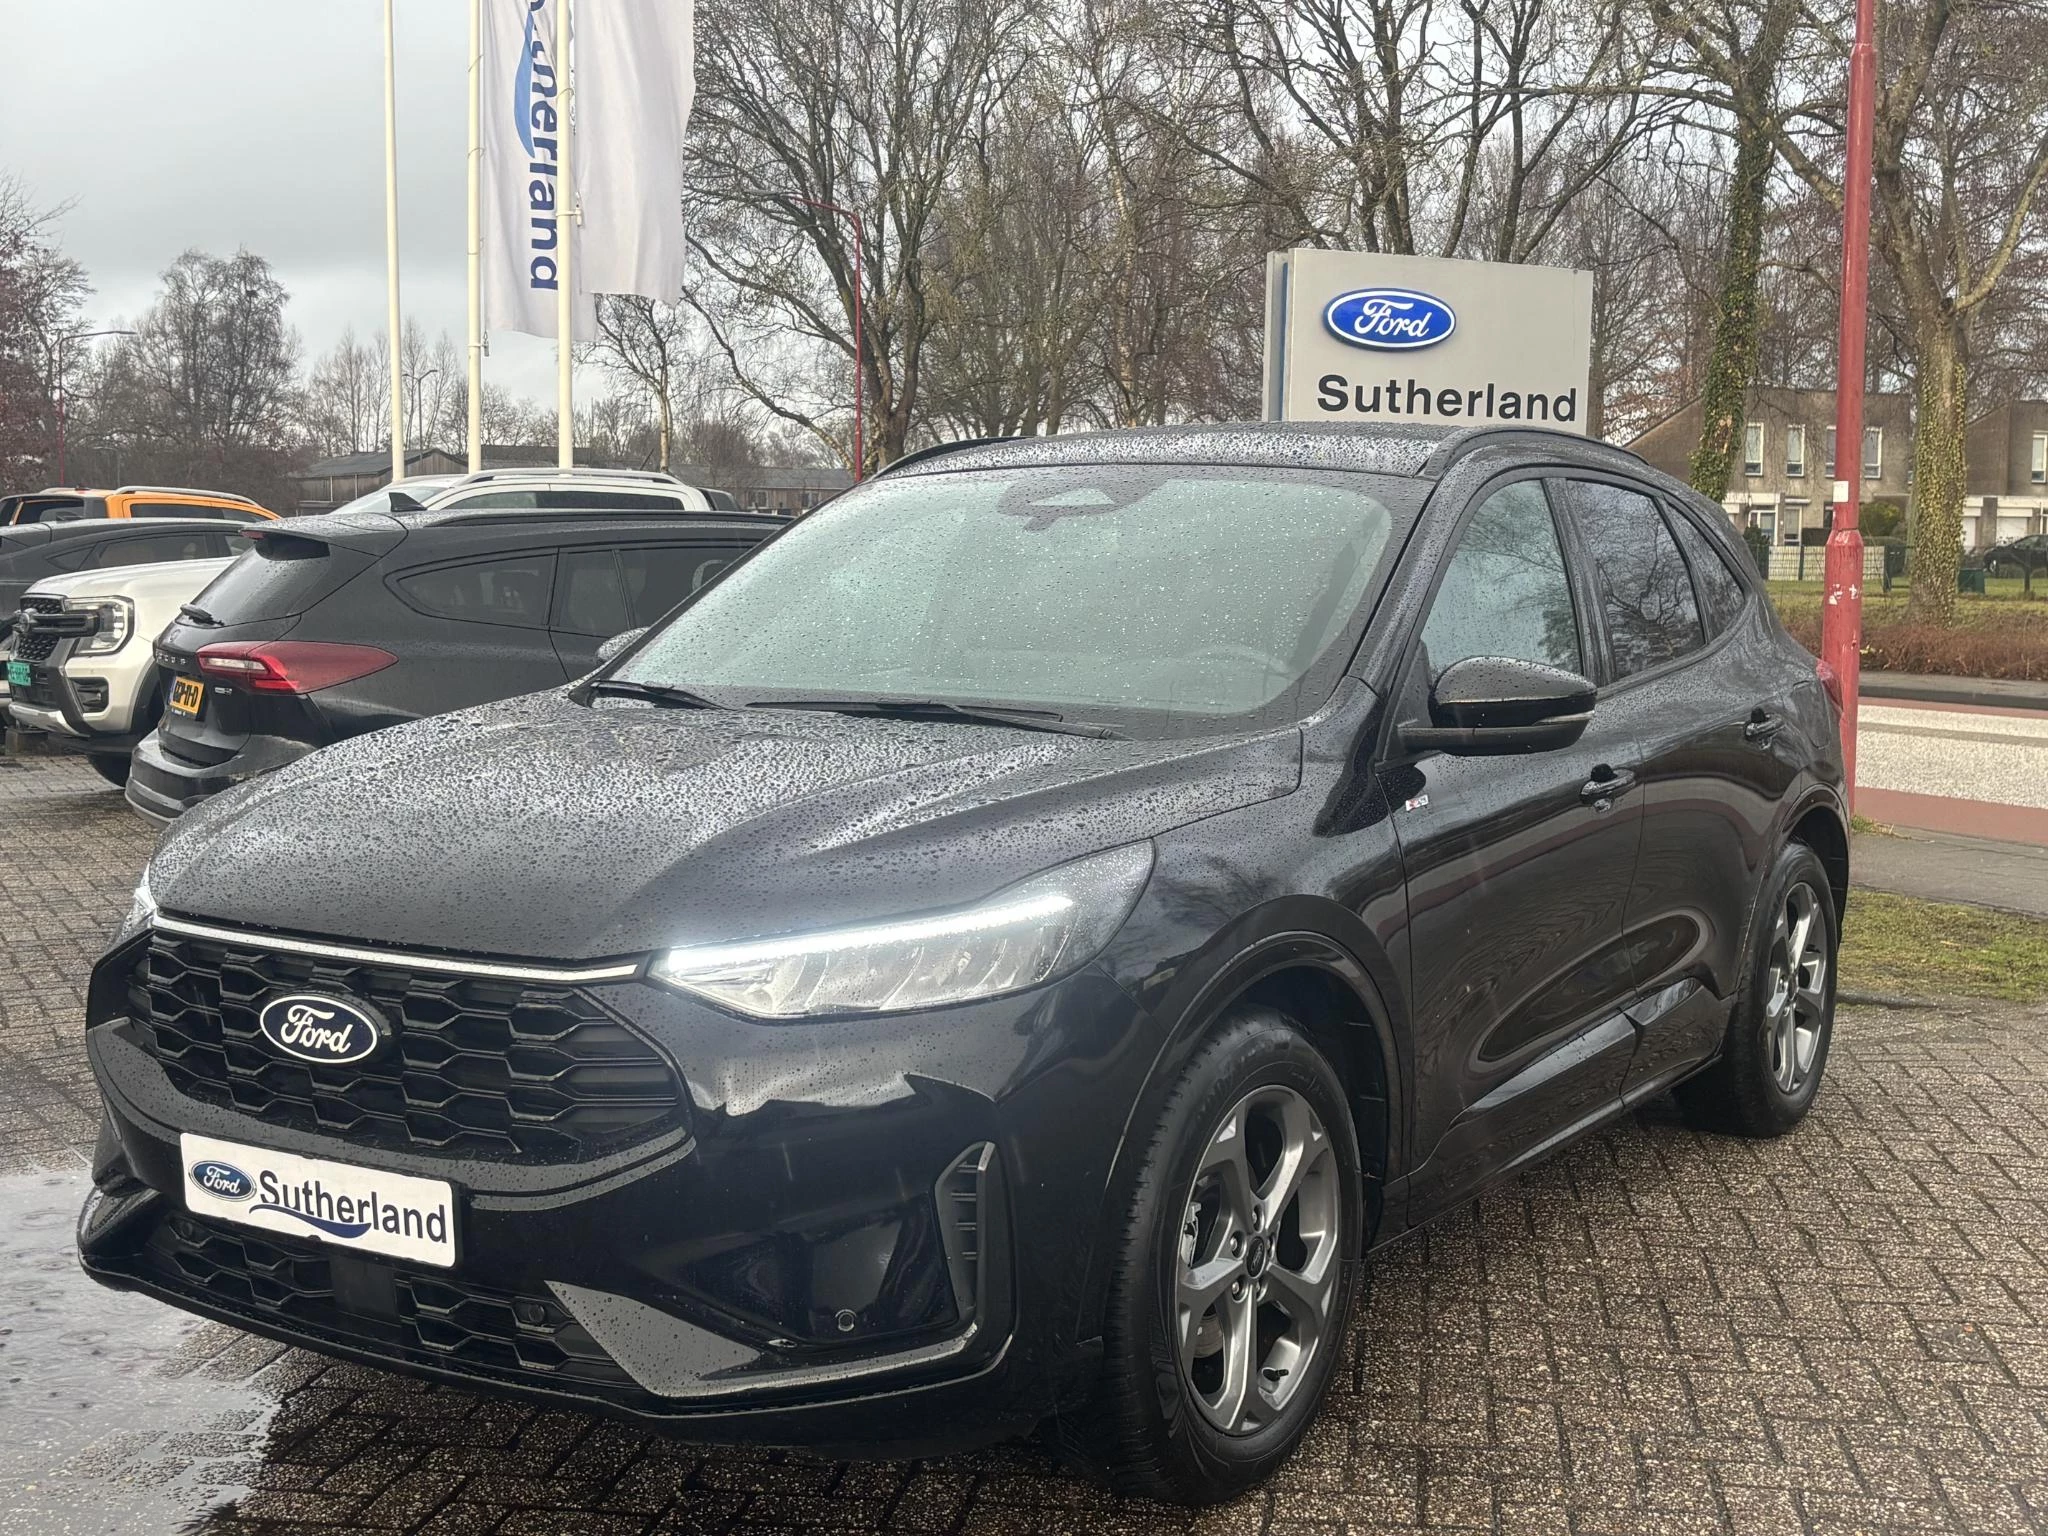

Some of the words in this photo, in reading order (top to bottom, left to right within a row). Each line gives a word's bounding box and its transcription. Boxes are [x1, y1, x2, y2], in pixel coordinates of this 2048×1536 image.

[1354, 299, 1430, 337] Ford
[1317, 374, 1577, 422] Sutherland
[281, 1005, 353, 1053] Ford
[203, 1165, 240, 1194] Ford
[259, 1170, 447, 1243] Sutherland
